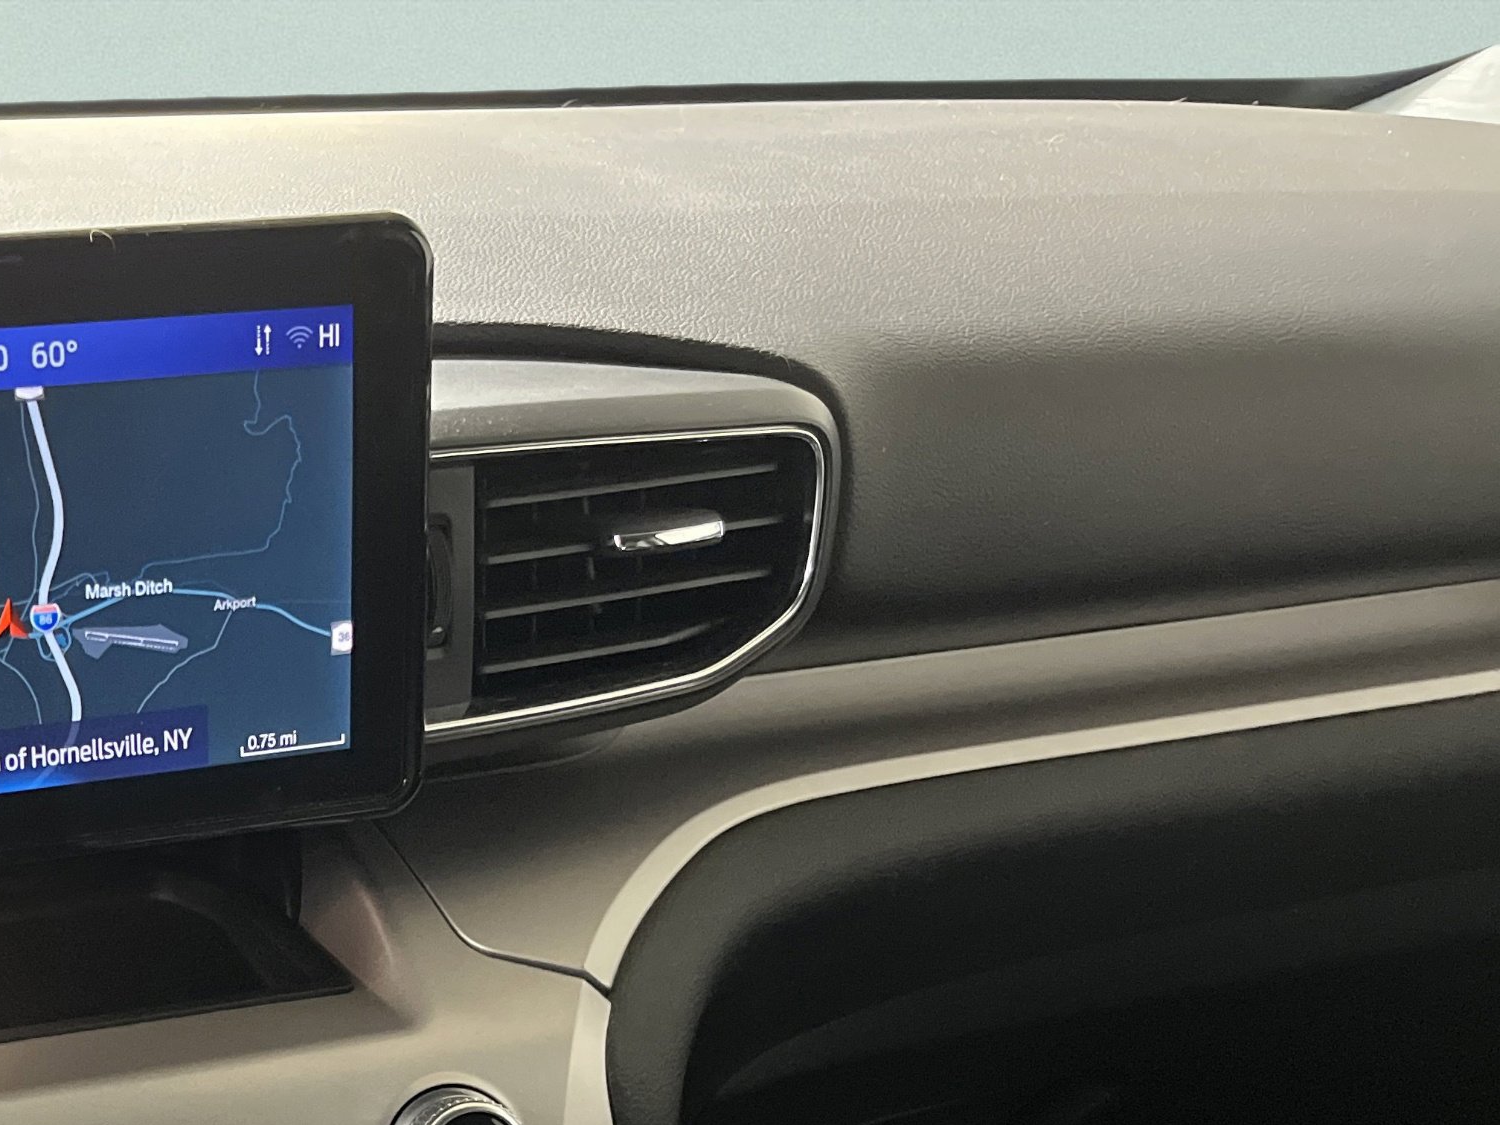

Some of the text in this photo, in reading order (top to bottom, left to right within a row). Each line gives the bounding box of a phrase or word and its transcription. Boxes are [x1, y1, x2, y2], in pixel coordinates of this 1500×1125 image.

[319, 323, 340, 348] HI
[31, 339, 78, 369] 60°
[85, 577, 173, 600] Marsh Ditch
[213, 595, 257, 612] Arkport
[4, 746, 28, 772] of
[30, 735, 160, 768] Hornellsville,
[163, 727, 193, 752] NY
[247, 730, 298, 751] 0.75 mi
